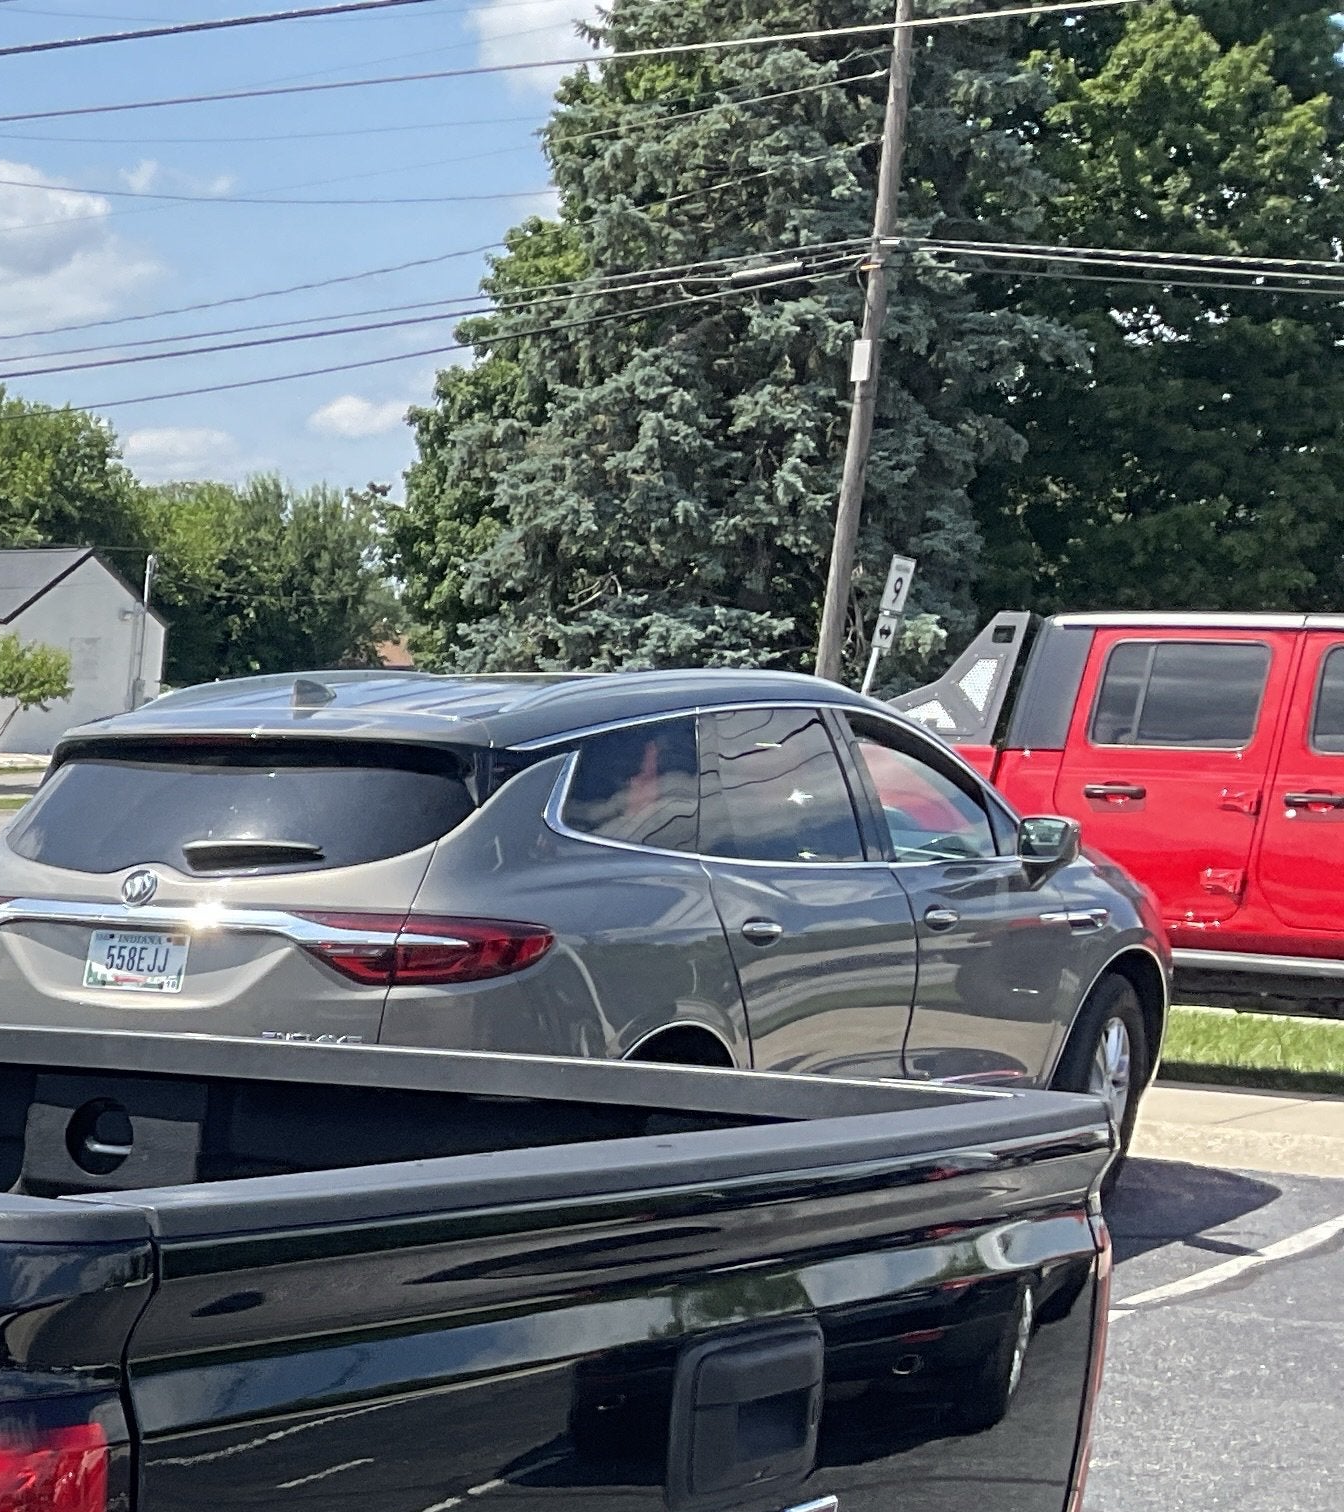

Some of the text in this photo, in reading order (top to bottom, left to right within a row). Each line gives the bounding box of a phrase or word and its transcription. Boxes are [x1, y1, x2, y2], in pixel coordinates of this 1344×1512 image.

[892, 577, 903, 603] 9
[118, 933, 163, 945] INDIANA
[105, 945, 170, 973] 558EJJ
